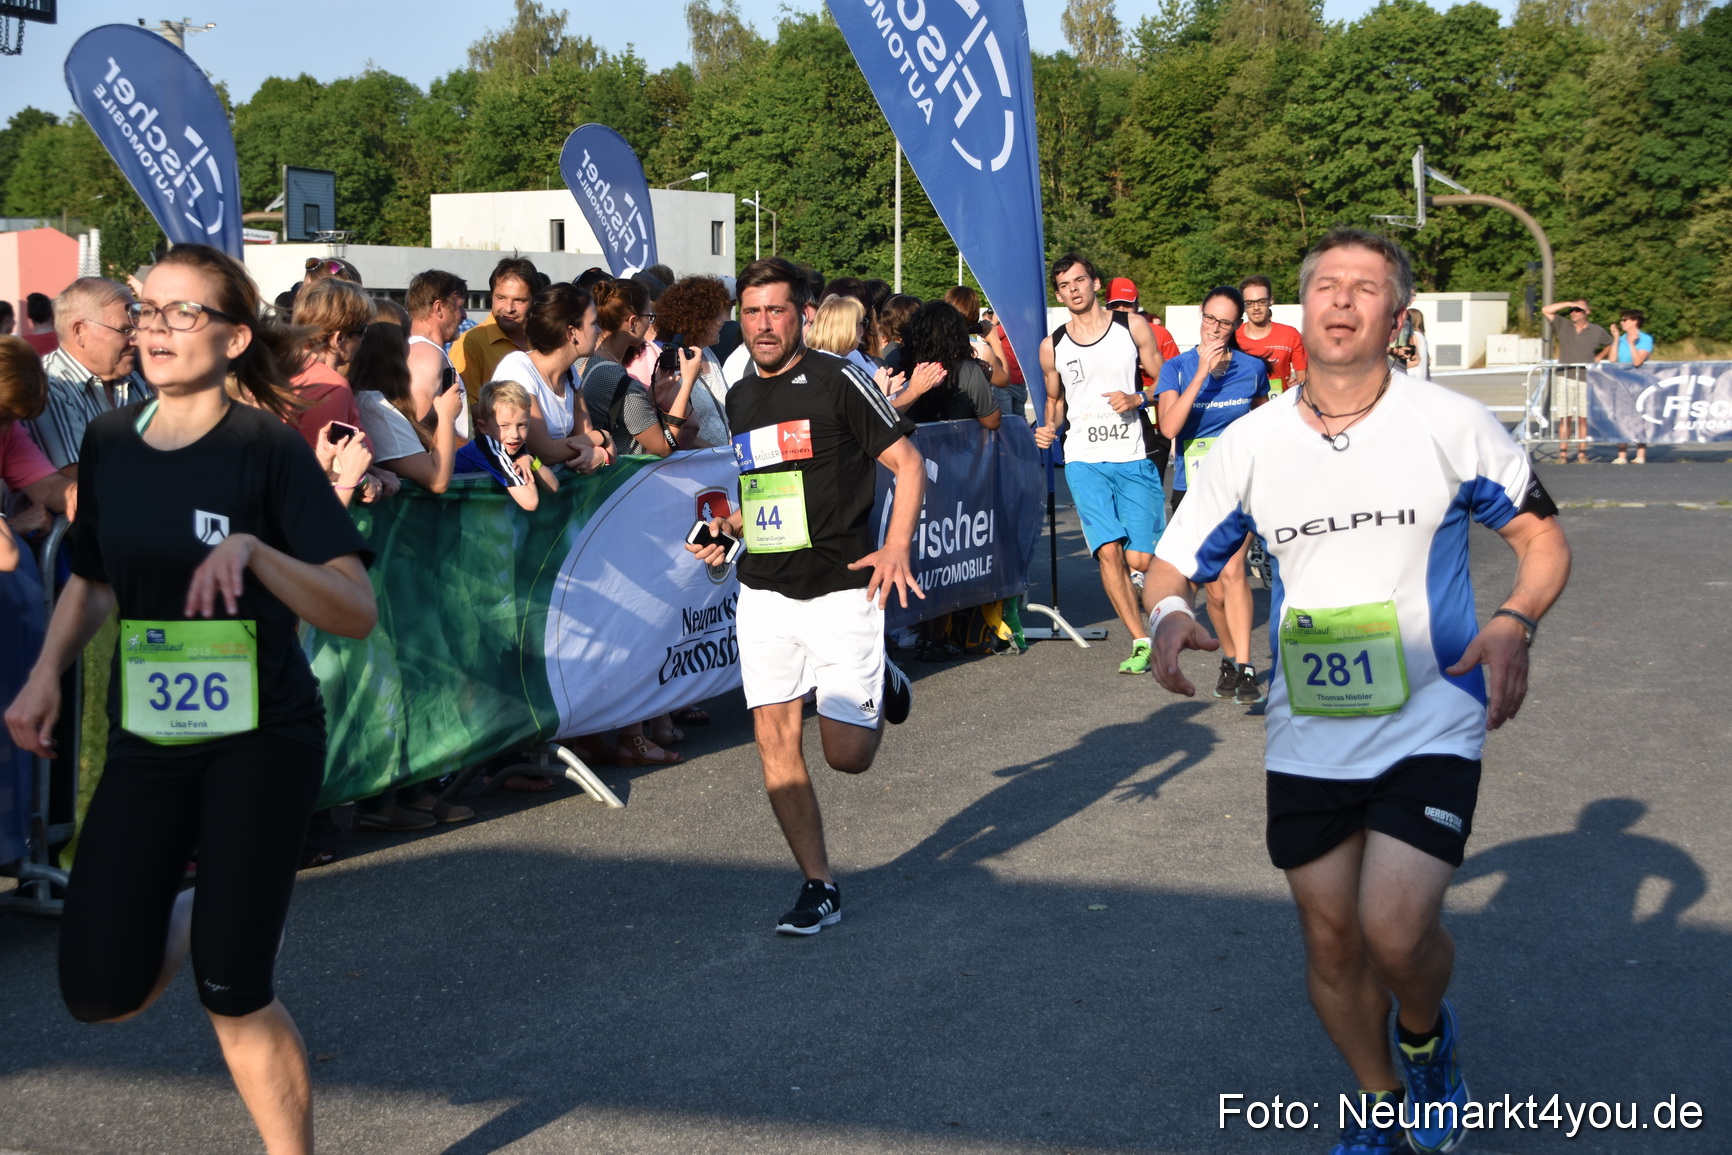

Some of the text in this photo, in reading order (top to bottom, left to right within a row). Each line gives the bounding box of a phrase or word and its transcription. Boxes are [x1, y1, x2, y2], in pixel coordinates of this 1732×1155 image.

[1662, 395, 1732, 418] Fisc
[1088, 423, 1130, 443] 8942
[1673, 420, 1732, 431] AUTOM
[664, 429, 677, 447] SONY
[756, 505, 783, 531] 44
[1274, 508, 1416, 545] DELPHI
[1302, 649, 1374, 687] 281
[148, 671, 230, 712] 326
[1316, 692, 1373, 701] Thomas Niebler
[170, 720, 208, 728] Lisa Fenk
